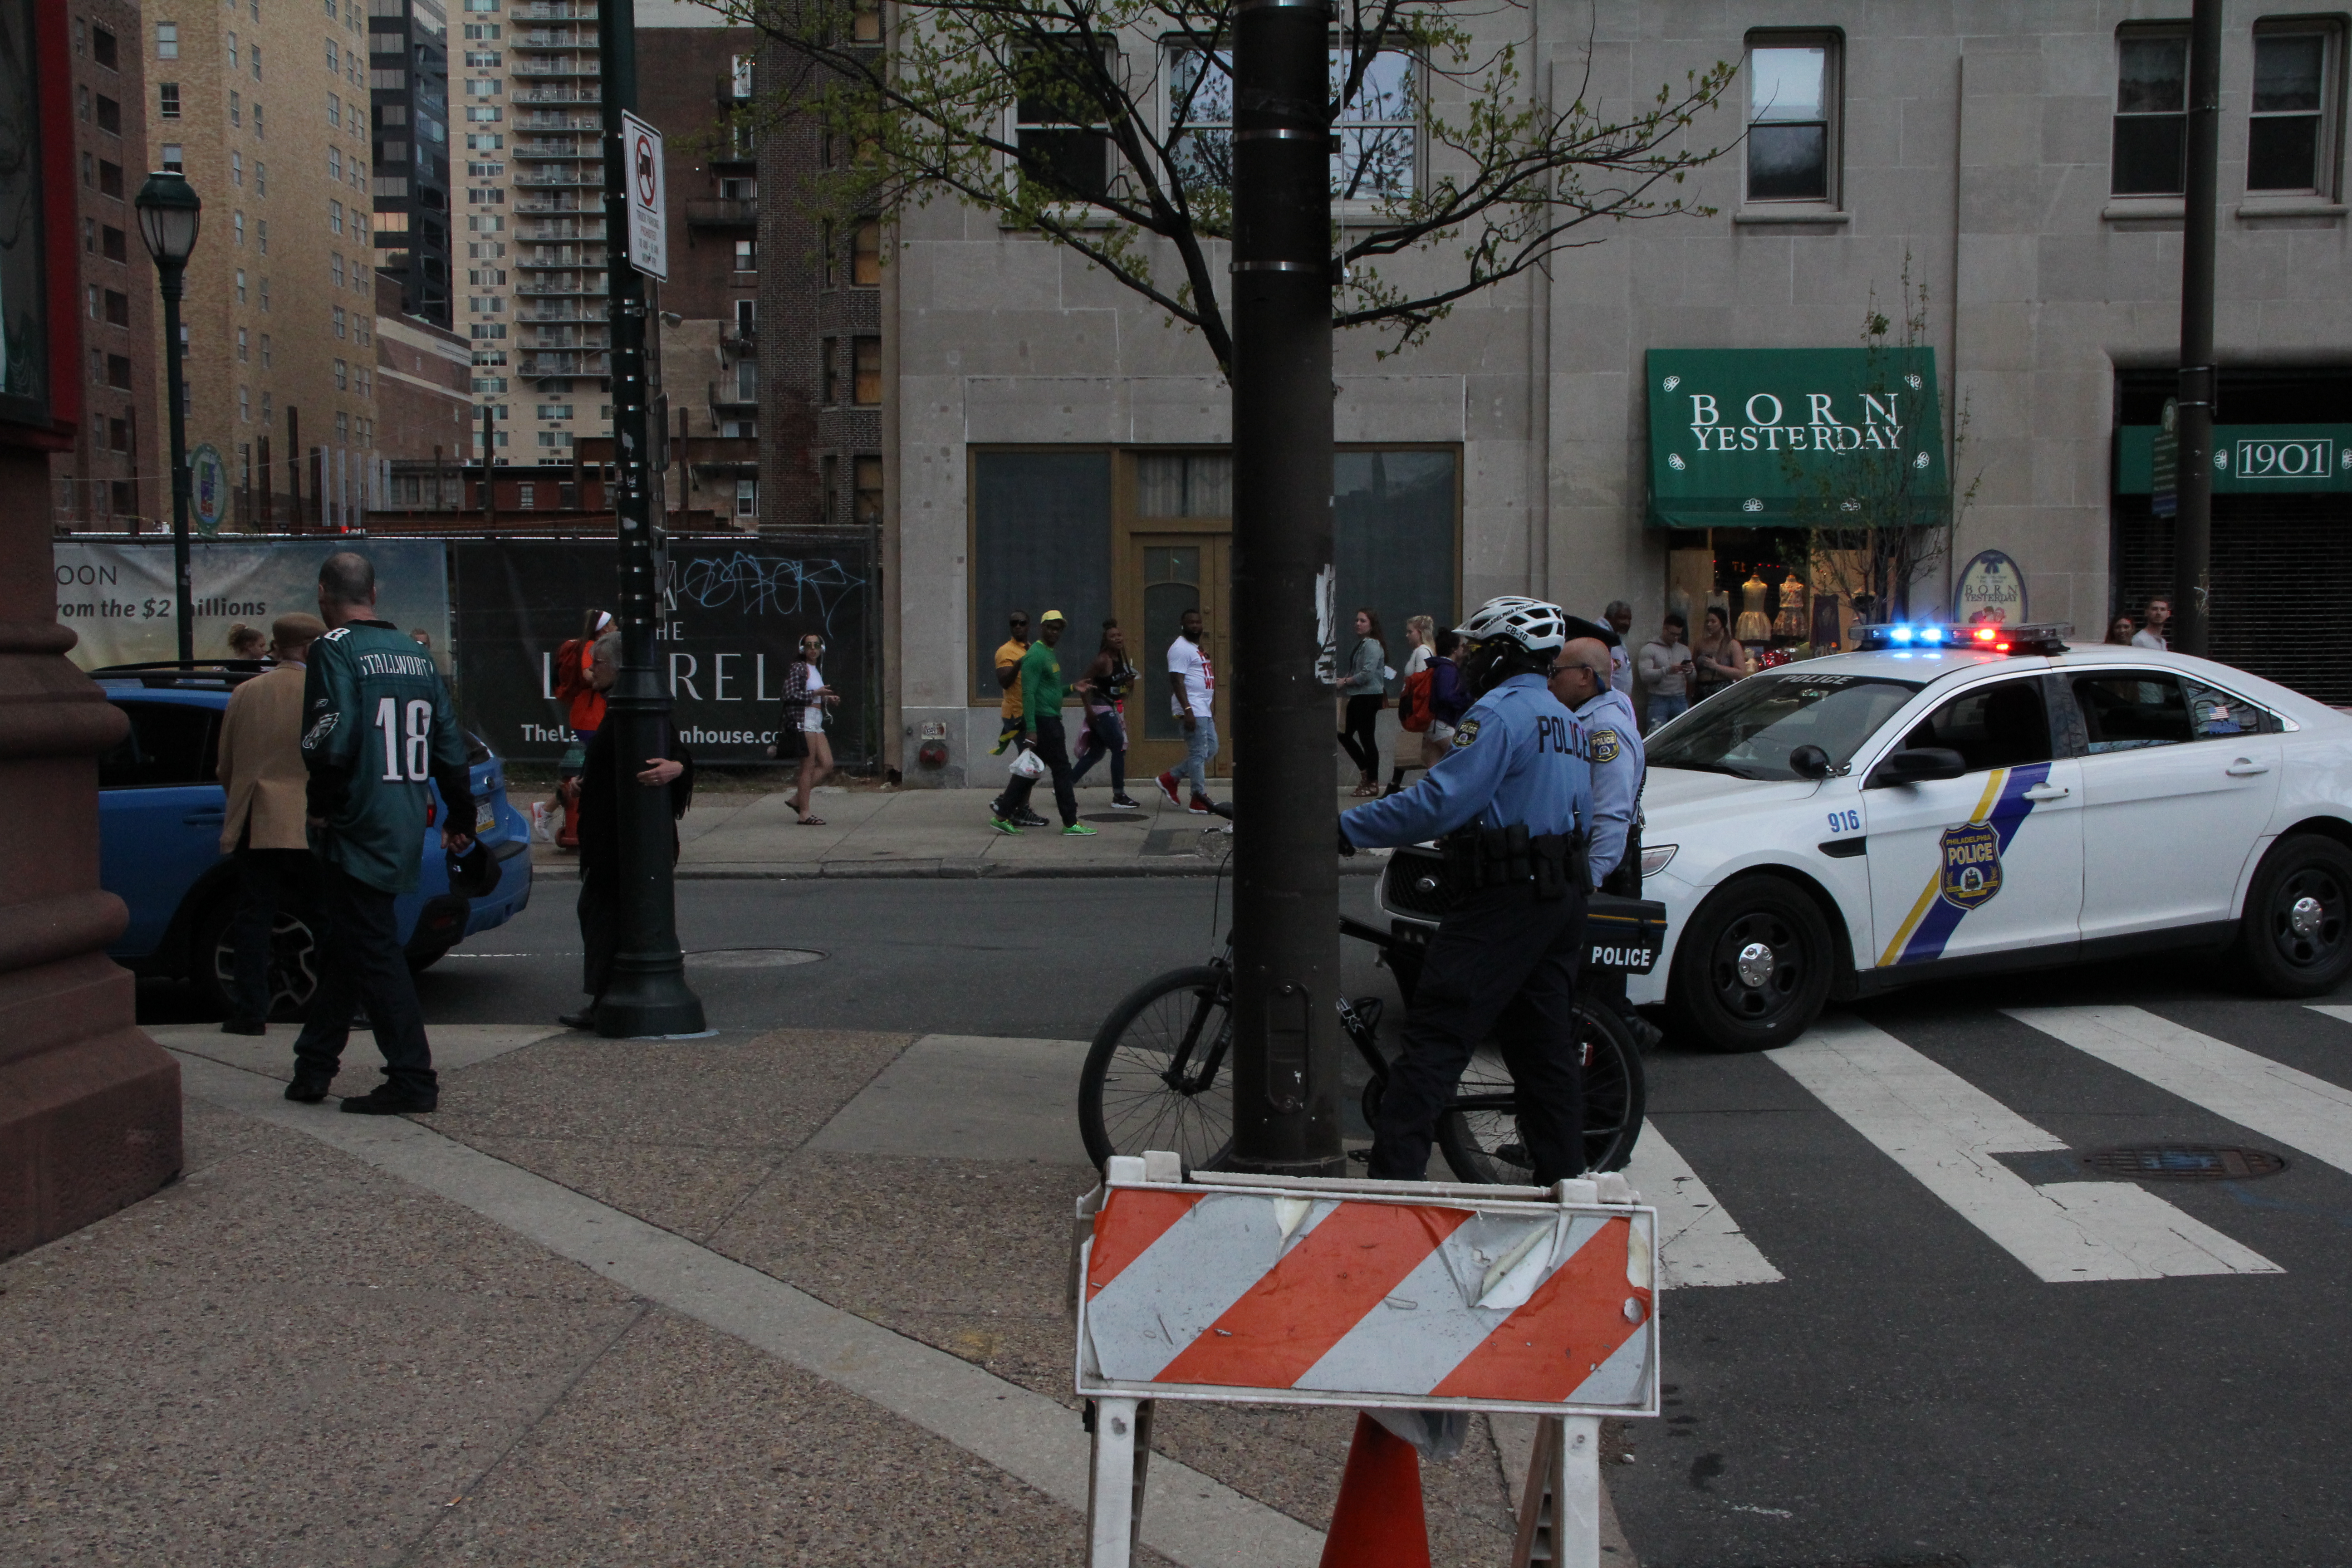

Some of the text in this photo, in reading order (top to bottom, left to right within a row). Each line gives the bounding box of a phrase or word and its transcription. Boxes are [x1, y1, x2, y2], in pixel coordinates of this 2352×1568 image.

[1689, 393, 1899, 426] BORN
[1690, 425, 1904, 455] YESTERDAY
[2241, 444, 2325, 474] 1901
[56, 565, 117, 585] OON
[1965, 584, 2018, 594] BORN
[1965, 593, 2018, 603] YESTERDAY
[101, 599, 135, 617] the
[142, 597, 171, 619] $2
[191, 598, 266, 616] illions
[1481, 603, 1534, 632] PHILADELPHIA POLICE
[656, 622, 684, 640] HE
[1505, 624, 1528, 641] CB-10
[543, 652, 780, 701] LREL
[1777, 675, 1854, 685] POLICE
[375, 697, 432, 781] 18
[1592, 736, 1615, 746] POLICE
[1828, 809, 1860, 833] 916
[1946, 834, 1992, 845] PHILADELPHIA
[1947, 843, 1994, 866] POLICE
[1592, 946, 1651, 966] POLICE
